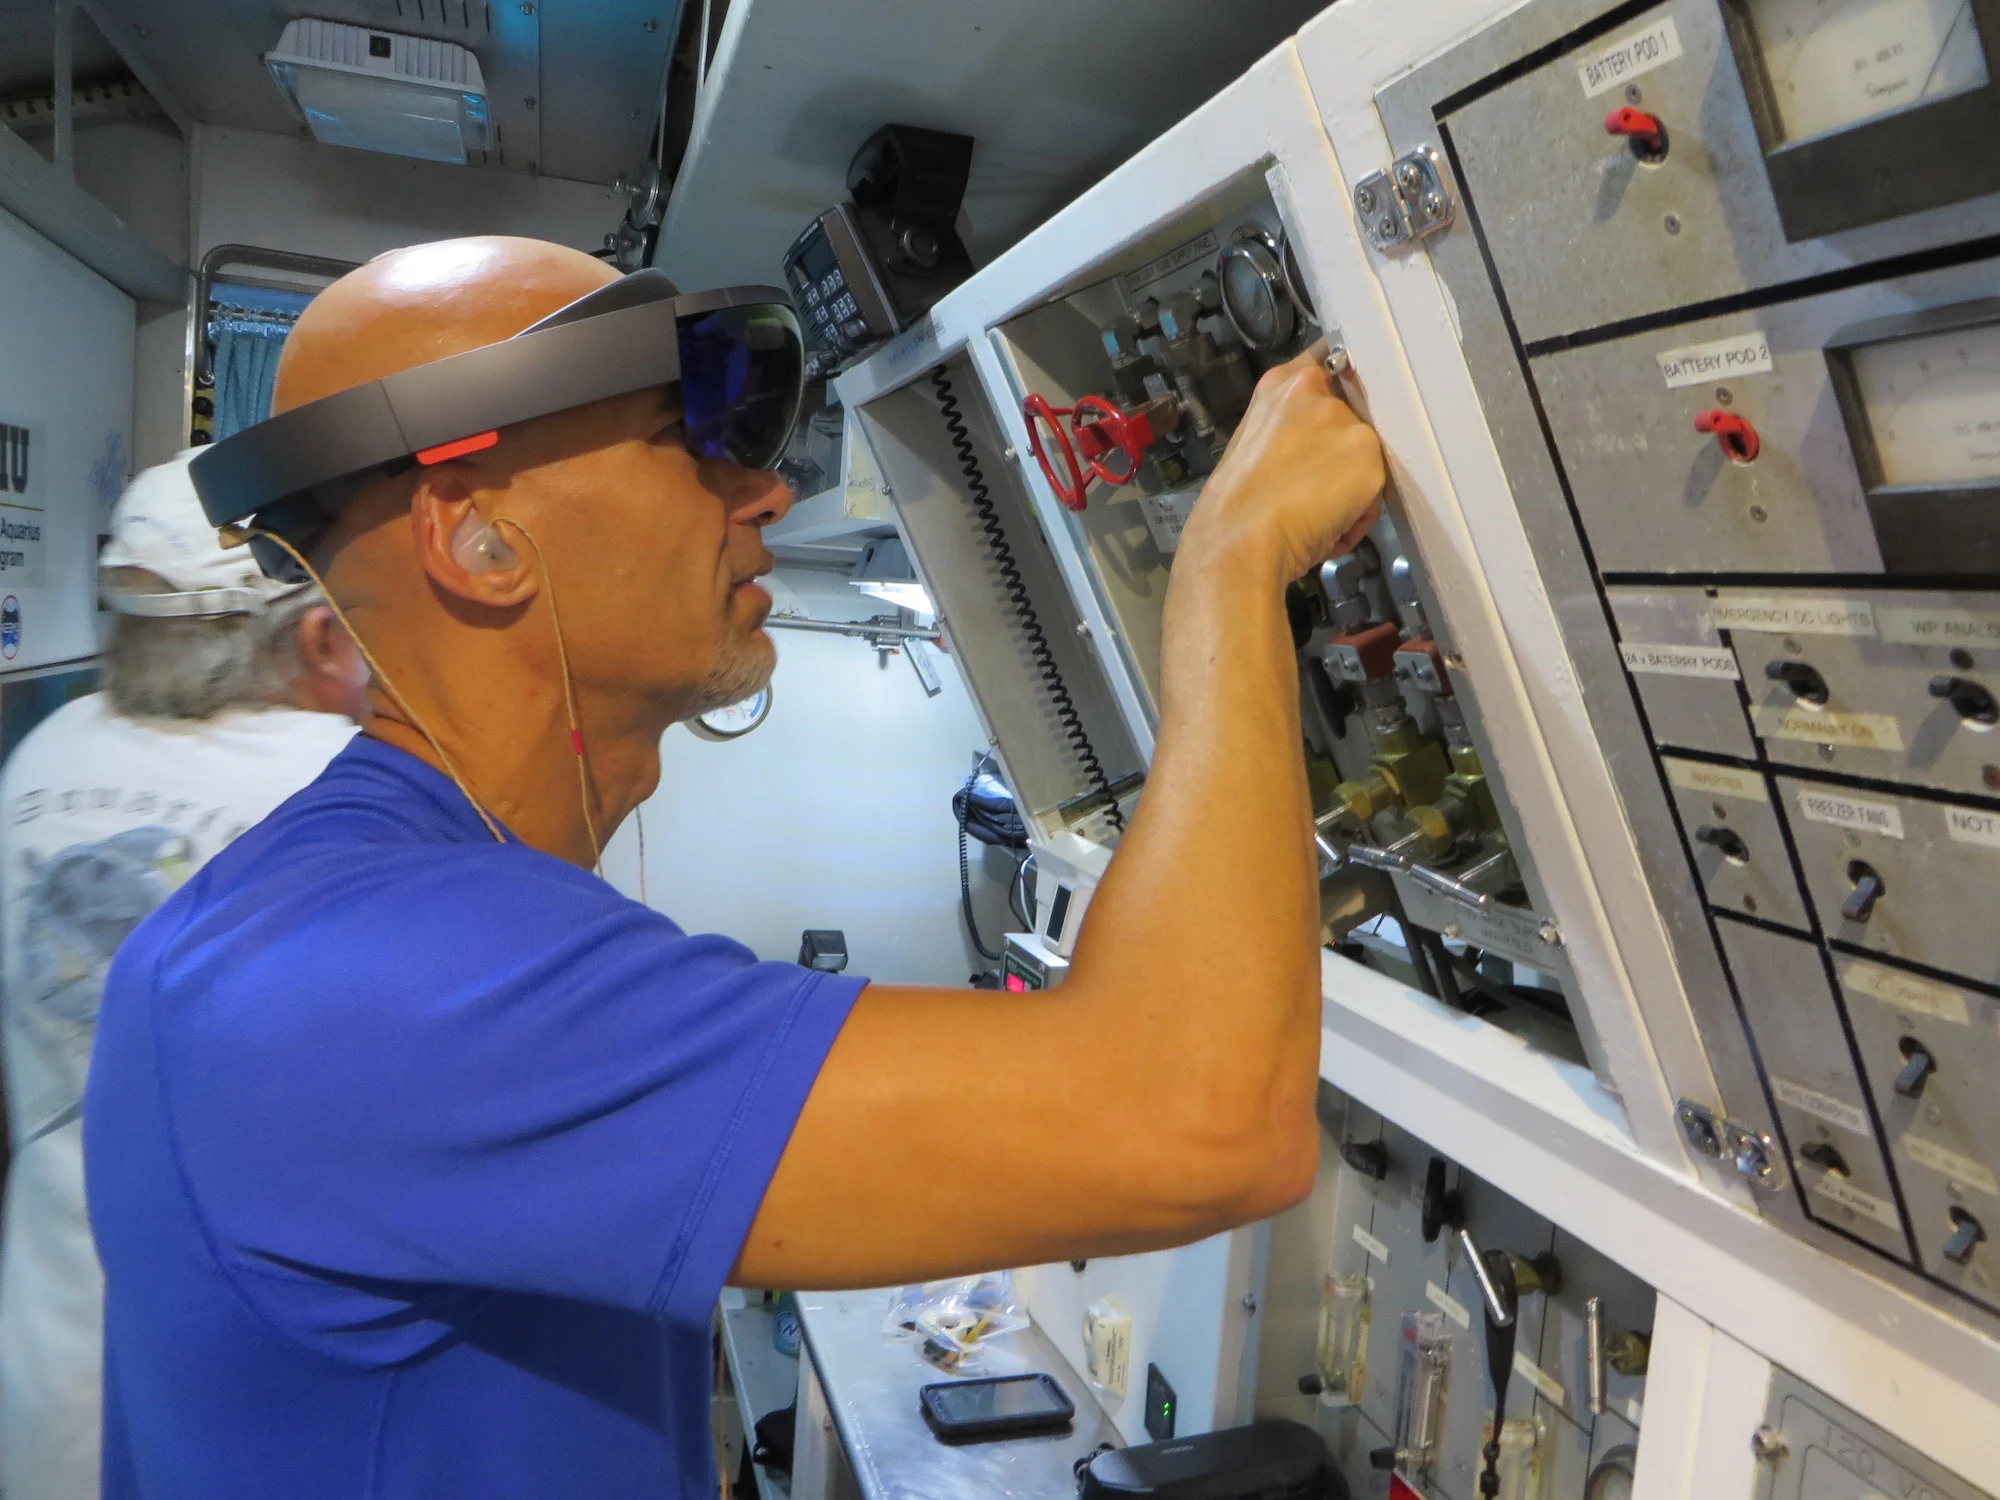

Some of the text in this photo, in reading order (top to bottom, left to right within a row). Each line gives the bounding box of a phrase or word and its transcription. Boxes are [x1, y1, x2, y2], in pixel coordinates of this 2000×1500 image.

[1586, 29, 1669, 88] BATTERY POD 1
[1664, 344, 1769, 379] BATTERY POD 2
[0, 515, 41, 542] Aquarius
[1952, 810, 1993, 835] NOT
